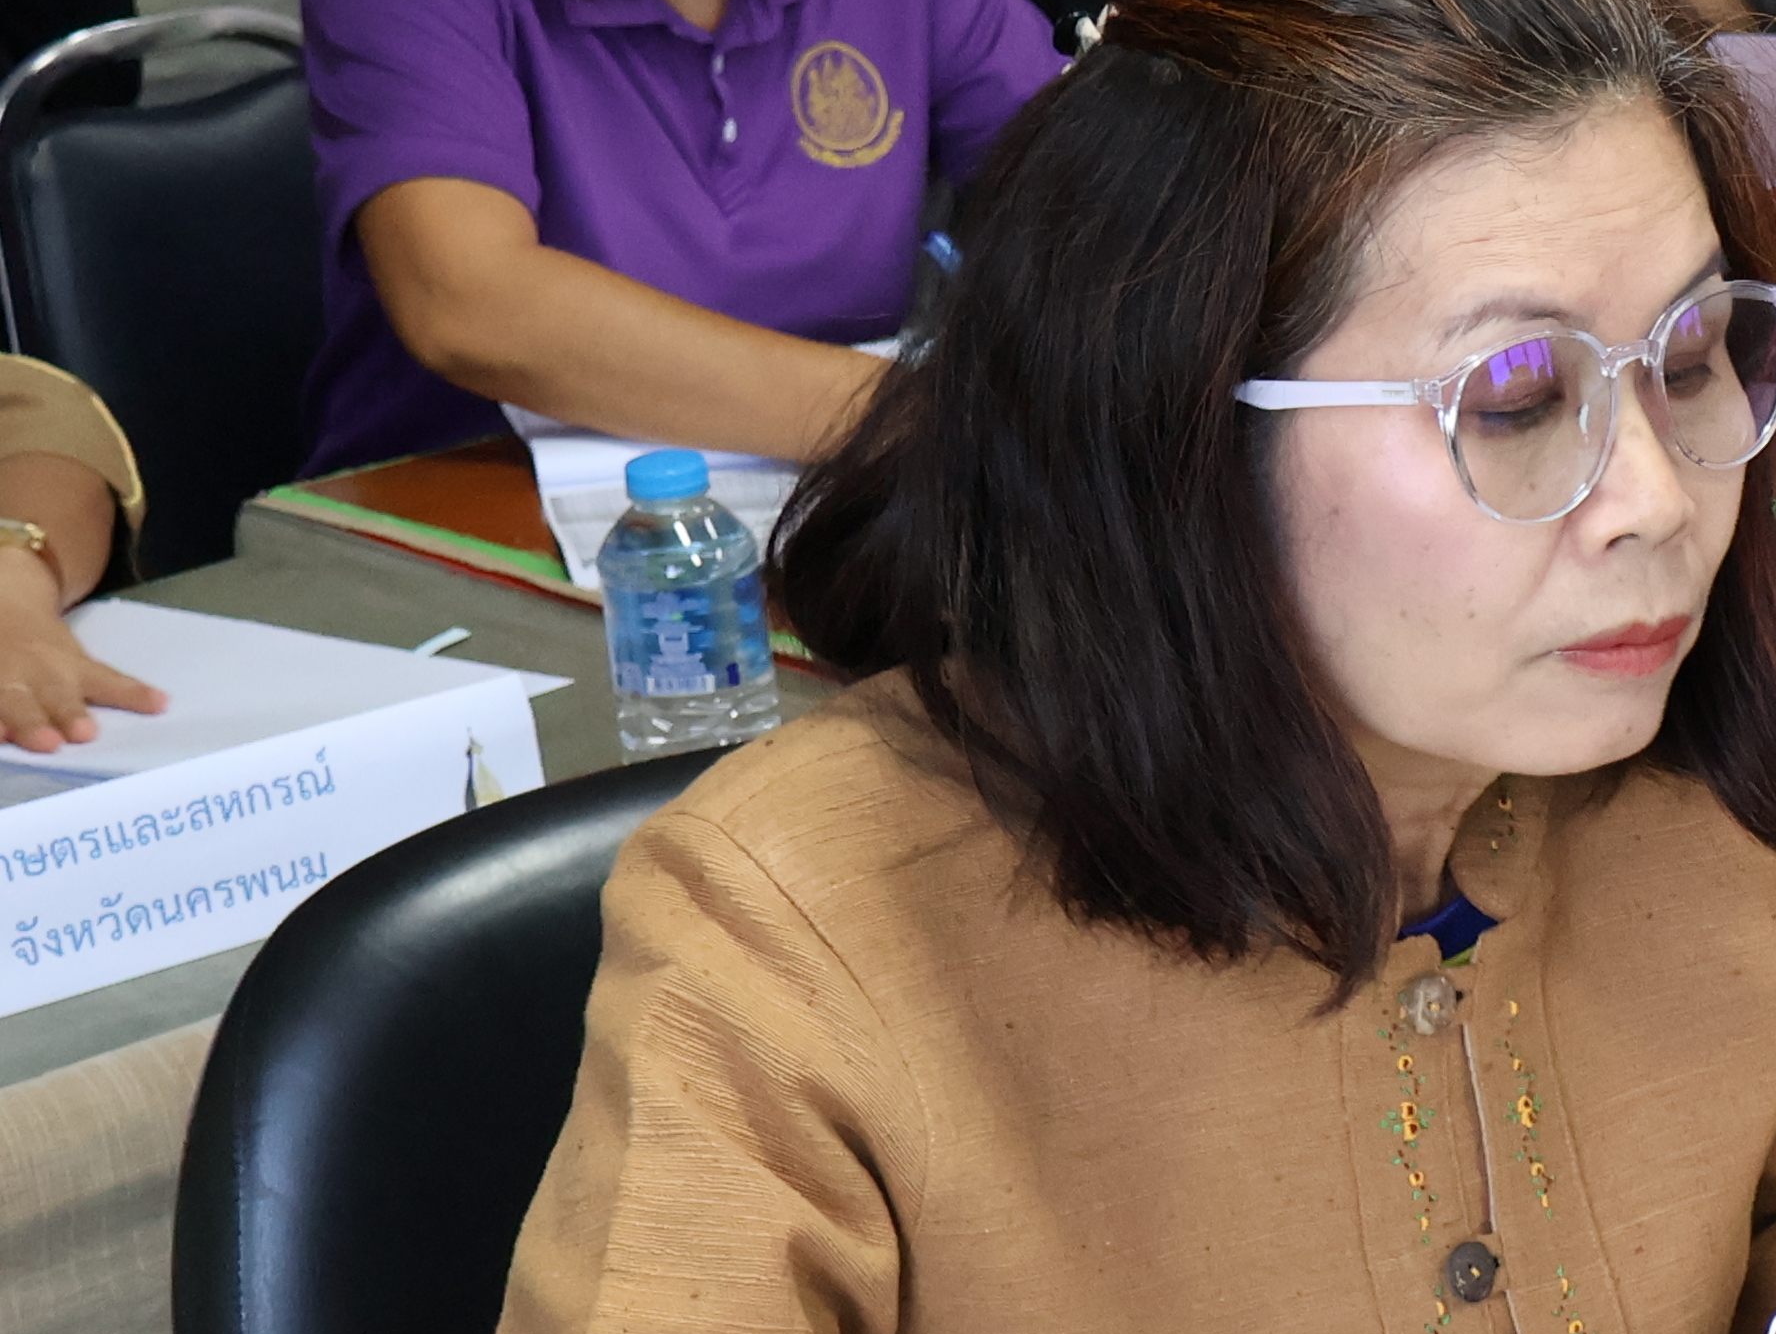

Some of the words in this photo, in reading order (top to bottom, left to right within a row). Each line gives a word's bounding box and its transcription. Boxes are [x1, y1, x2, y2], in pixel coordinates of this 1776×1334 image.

[11, 851, 329, 967] จังหวัดนครพนม
